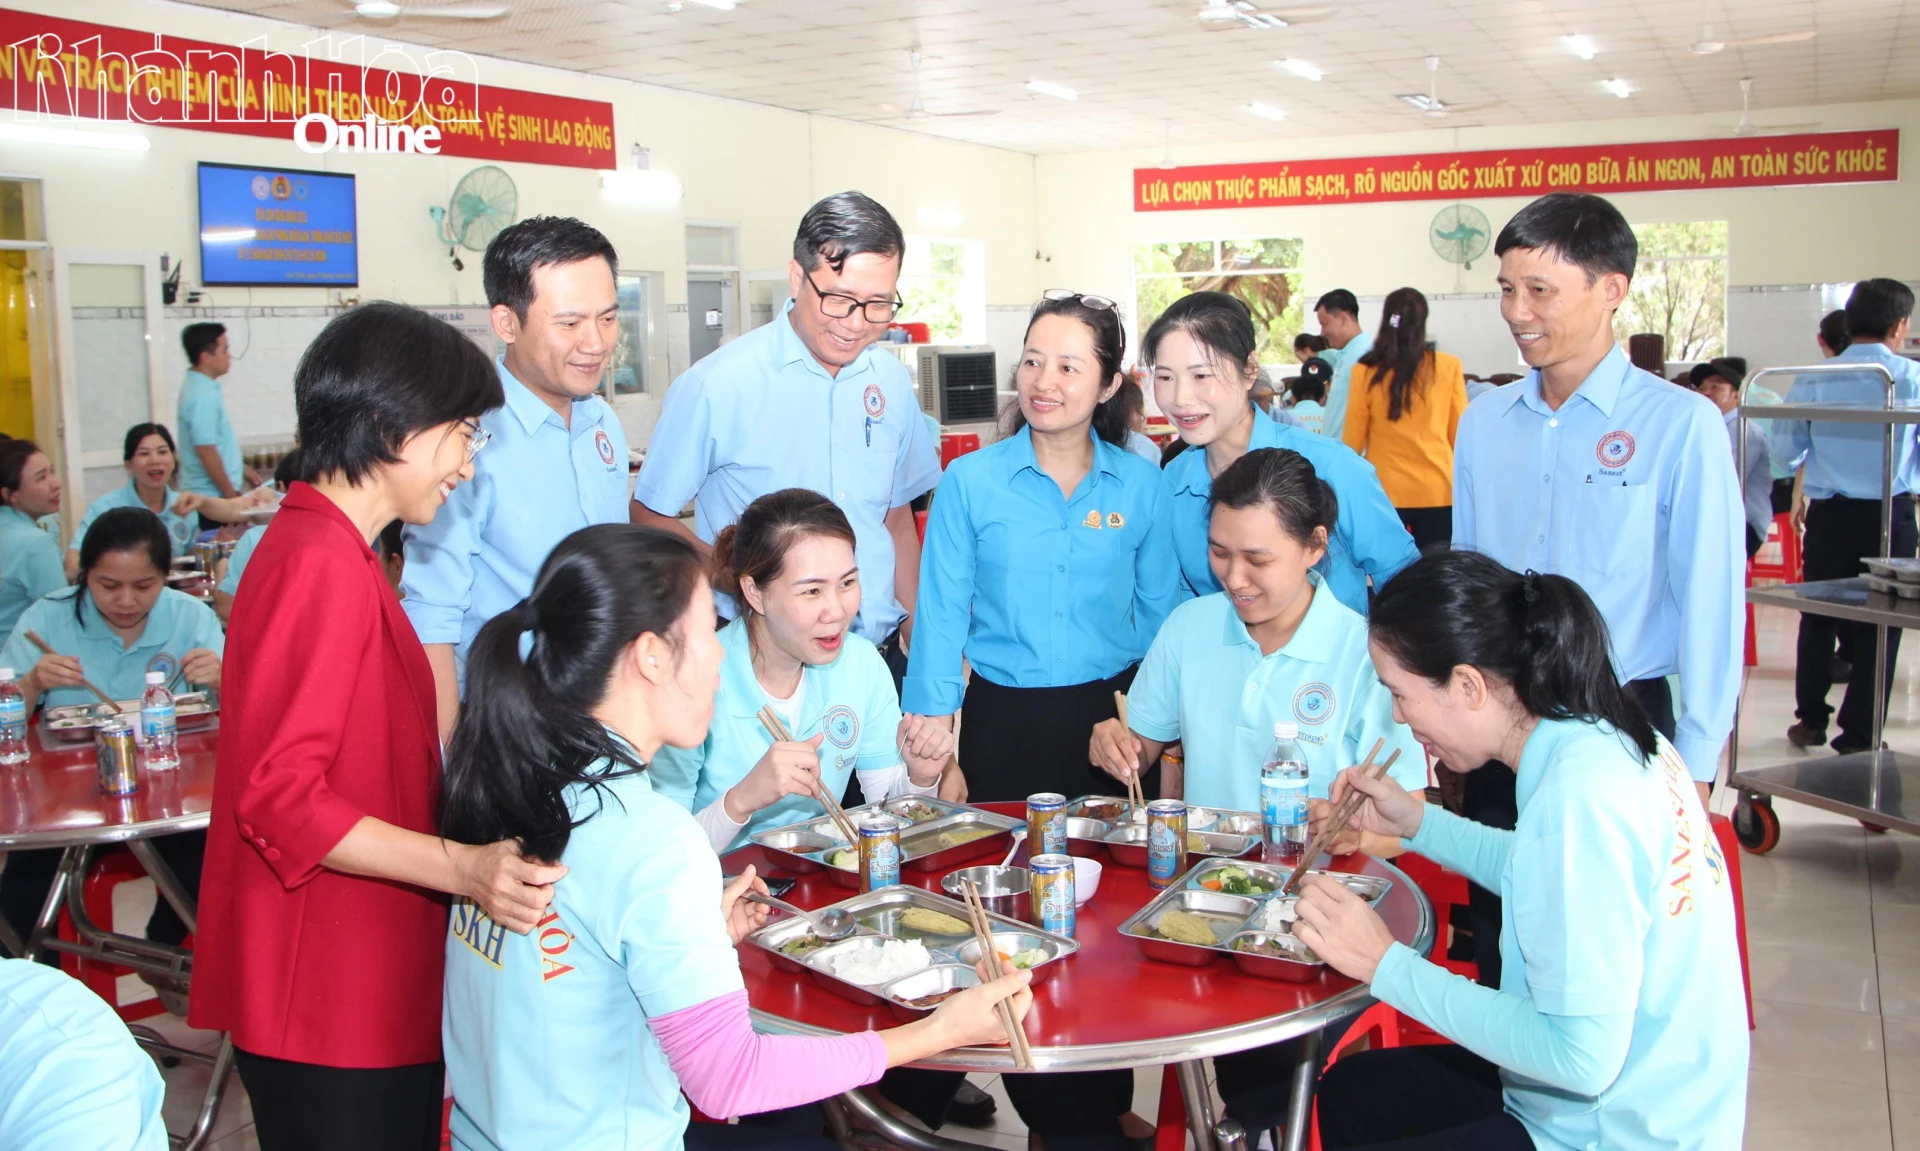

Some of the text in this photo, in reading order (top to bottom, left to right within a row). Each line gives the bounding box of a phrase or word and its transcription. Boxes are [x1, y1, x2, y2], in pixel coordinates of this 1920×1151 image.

[20, 39, 57, 86] VÀ
[60, 49, 140, 96] TRÁCH
[145, 61, 210, 112] NHIỆM
[217, 68, 259, 111] CỦA
[263, 74, 310, 115] MÌNH
[314, 87, 362, 121] THEO
[412, 104, 434, 128] AN
[437, 100, 484, 142] TOÀN,
[485, 105, 506, 146] VỆ
[508, 113, 543, 144] SINH
[544, 119, 571, 146] LAO
[574, 117, 612, 154] ĐỘNG
[1142, 140, 1887, 207] LỰA CHỌN THỰC PHẨM SẠCH, RÕ NGUỒN GỐC XUẤT XỨ CHO BỮA ĂN NGON, AN TOÀN SỨC KHỎE
